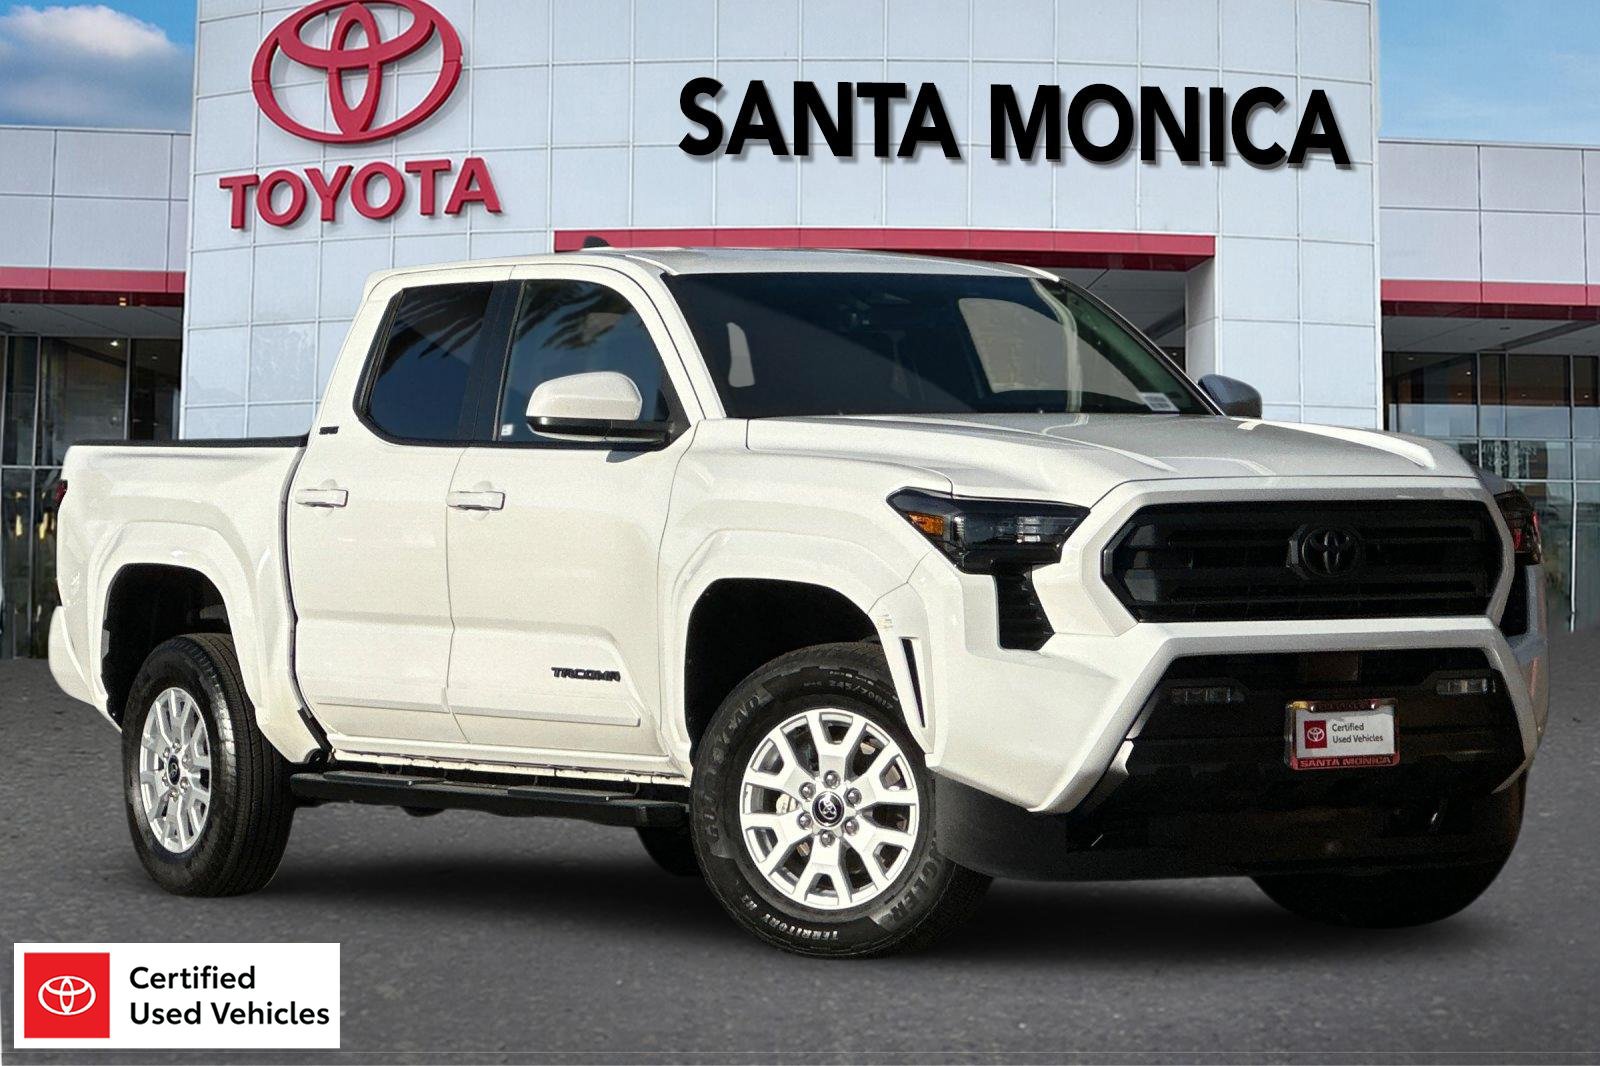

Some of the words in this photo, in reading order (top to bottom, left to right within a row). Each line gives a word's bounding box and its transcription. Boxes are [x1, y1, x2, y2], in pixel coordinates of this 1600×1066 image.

[678, 77, 961, 160] SANTA
[990, 83, 1351, 168] MONICA
[219, 157, 502, 229] TOYOTA
[551, 667, 621, 682] TACOMA
[1331, 723, 1365, 732] Certified
[1332, 735, 1352, 744] Used
[1353, 734, 1384, 743] Vehicles
[1300, 759, 1340, 768] SANTA
[1343, 756, 1392, 766] MONICA
[763, 913, 839, 940] TERRITORY
